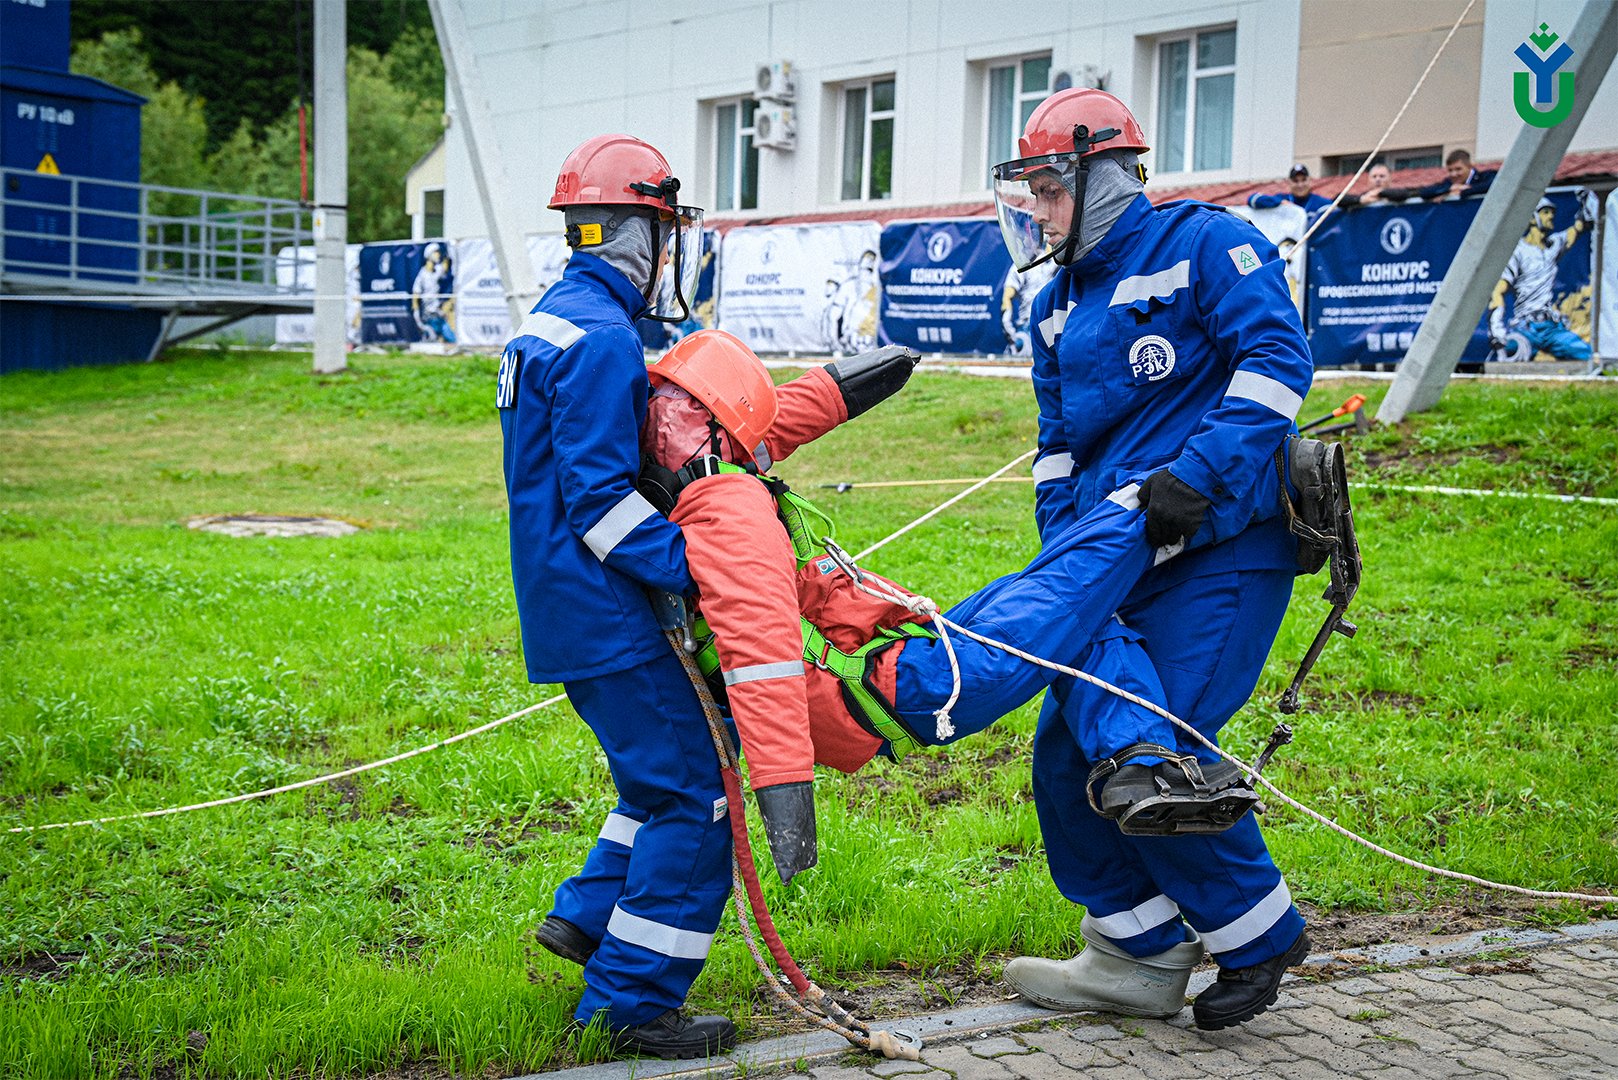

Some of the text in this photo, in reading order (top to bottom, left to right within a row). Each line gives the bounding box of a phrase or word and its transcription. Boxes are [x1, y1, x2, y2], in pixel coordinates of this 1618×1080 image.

[910, 267, 964, 285] КОНКУРС
[1361, 260, 1430, 282] КОНКУРС
[1318, 281, 1416, 299] ПРОФЕССИОНАЛЬНОГО
[1132, 358, 1166, 378] РЭК
[496, 350, 518, 408] ЭК
